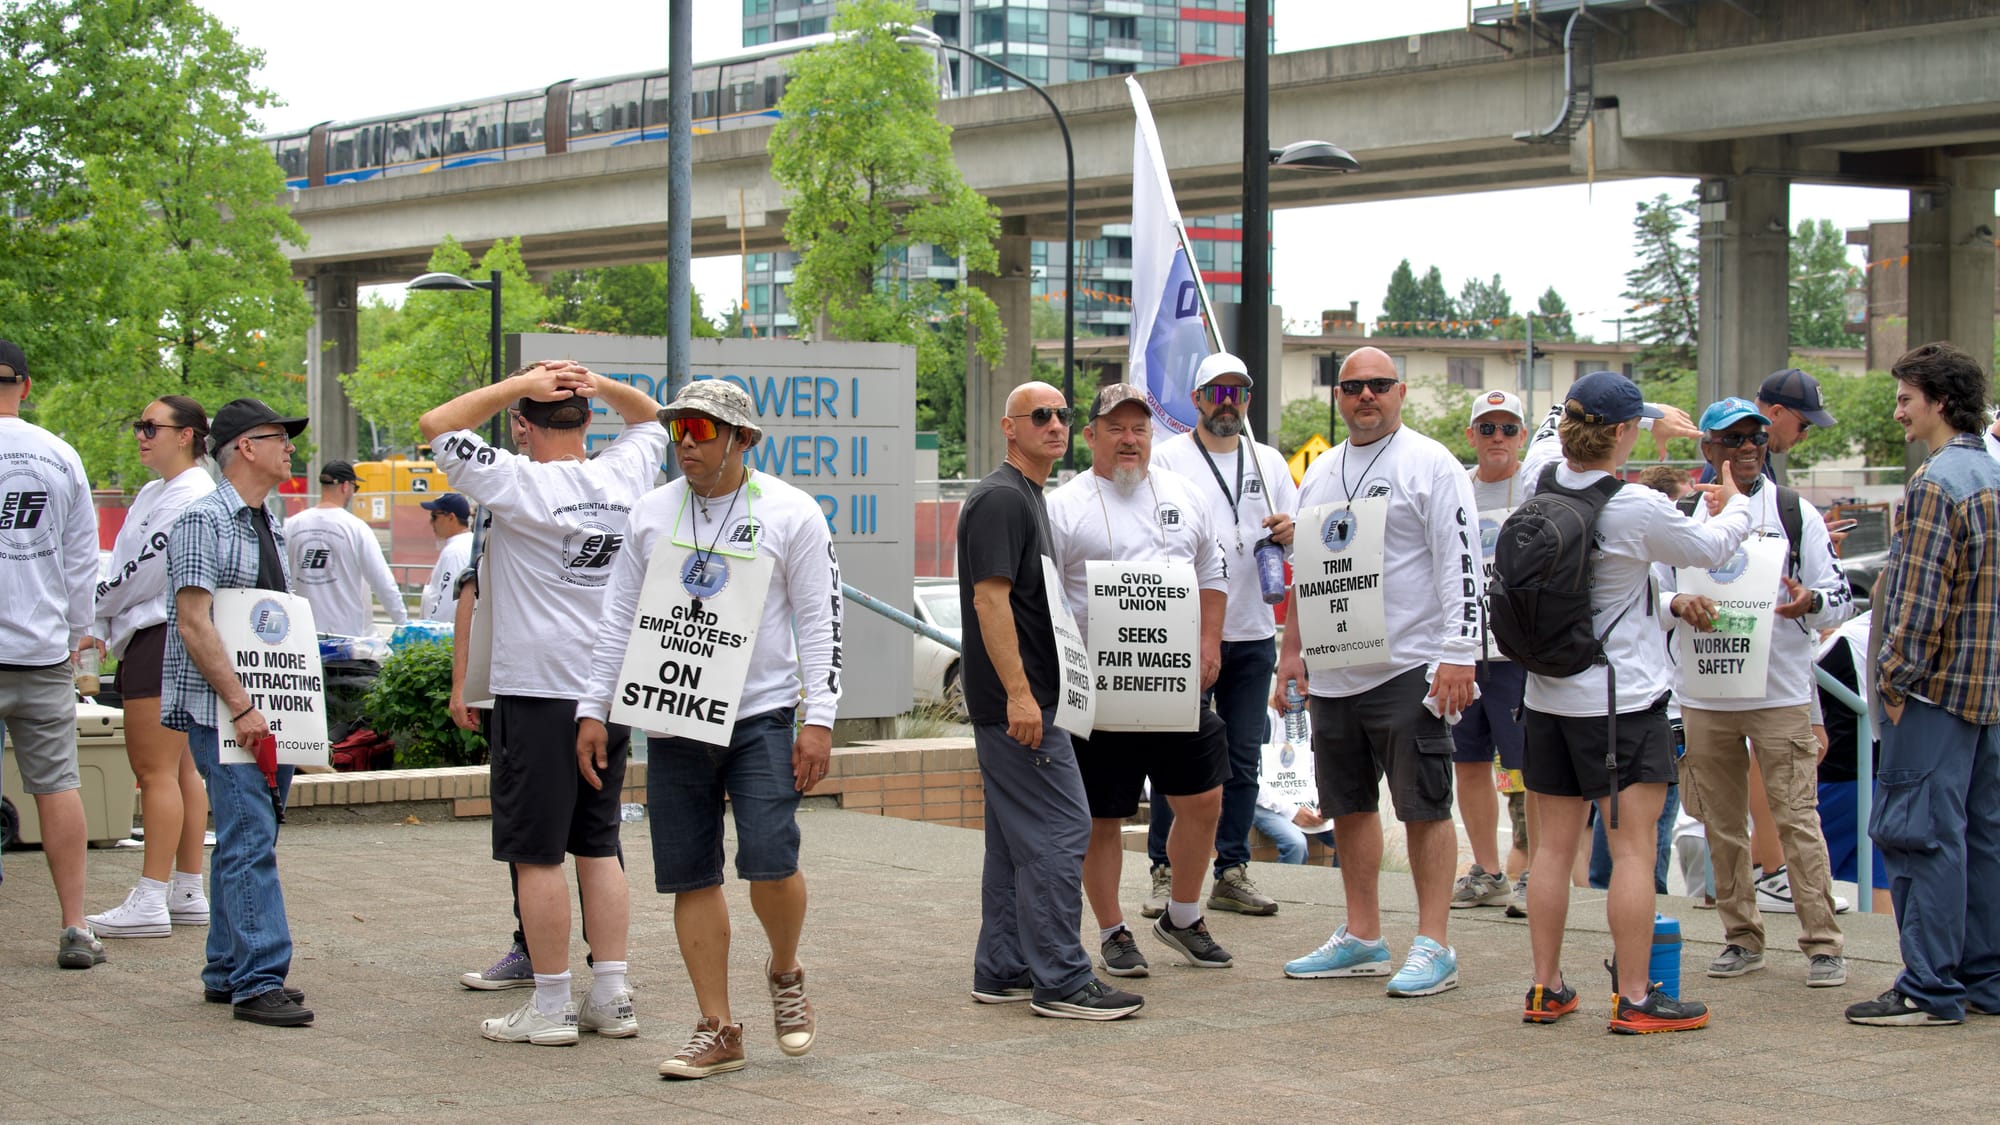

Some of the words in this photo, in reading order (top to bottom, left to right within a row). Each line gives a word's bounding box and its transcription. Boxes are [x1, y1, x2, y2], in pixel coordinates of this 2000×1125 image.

[852, 377, 859, 417] I
[852, 436, 867, 476] II
[852, 495, 877, 534] III
[1323, 557, 1352, 575] TRIM
[1121, 573, 1162, 585] GVRD
[1300, 573, 1379, 598] MANAGEMENT
[1095, 585, 1190, 598] EMPLOYEES'
[1119, 600, 1166, 611] UNION
[1330, 598, 1349, 613] FAT
[671, 605, 718, 626] GVRD
[639, 615, 747, 648] EMPLOYEES'
[1118, 627, 1168, 643] SEEKS
[1337, 620, 1347, 632] at
[660, 635, 714, 658] UNION
[1306, 638, 1384, 656] metrovancouver
[1693, 638, 1750, 653] WORKER
[237, 651, 259, 667] NO
[264, 652, 306, 670] MORE
[1098, 651, 1132, 667] FAIR
[1138, 652, 1191, 668] WAGES
[1698, 659, 1745, 674] SAFETY
[235, 672, 321, 692] NTRACTING
[659, 661, 702, 690] ON
[1096, 675, 1108, 690] &
[1113, 676, 1187, 692] BENEFITS
[269, 694, 313, 712] WORK
[622, 682, 729, 725] STRIKE
[1068, 689, 1088, 711] SAFETY
[269, 718, 282, 731] at
